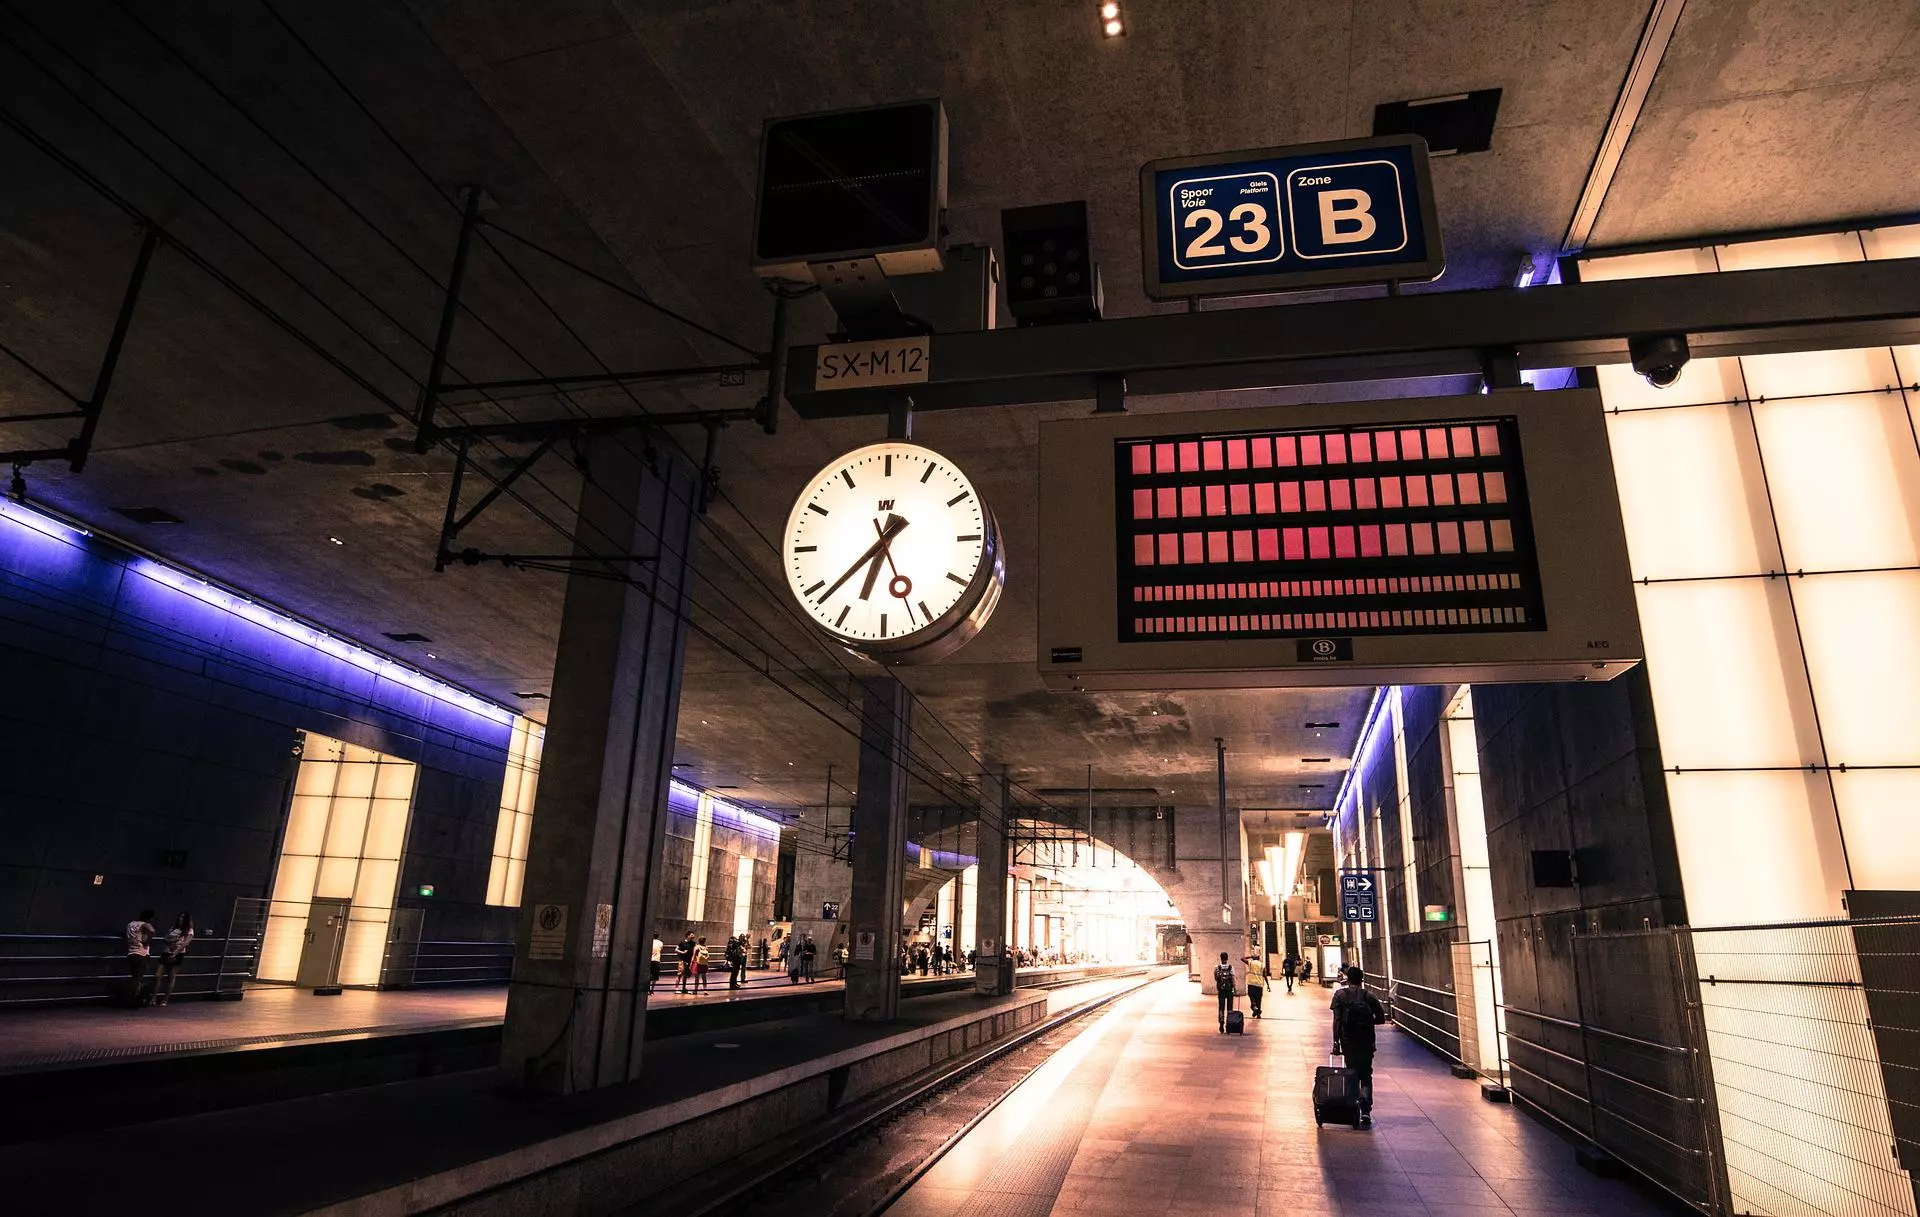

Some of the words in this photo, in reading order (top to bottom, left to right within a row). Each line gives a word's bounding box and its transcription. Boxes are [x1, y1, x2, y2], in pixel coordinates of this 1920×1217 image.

[1298, 176, 1332, 187] Zone
[1181, 188, 1214, 200] Spoor
[1181, 198, 1206, 208] Voie
[1318, 188, 1377, 245] B
[1184, 203, 1271, 259] 23
[822, 347, 924, 379] SX-M.12
[1587, 640, 1609, 648] AEG
